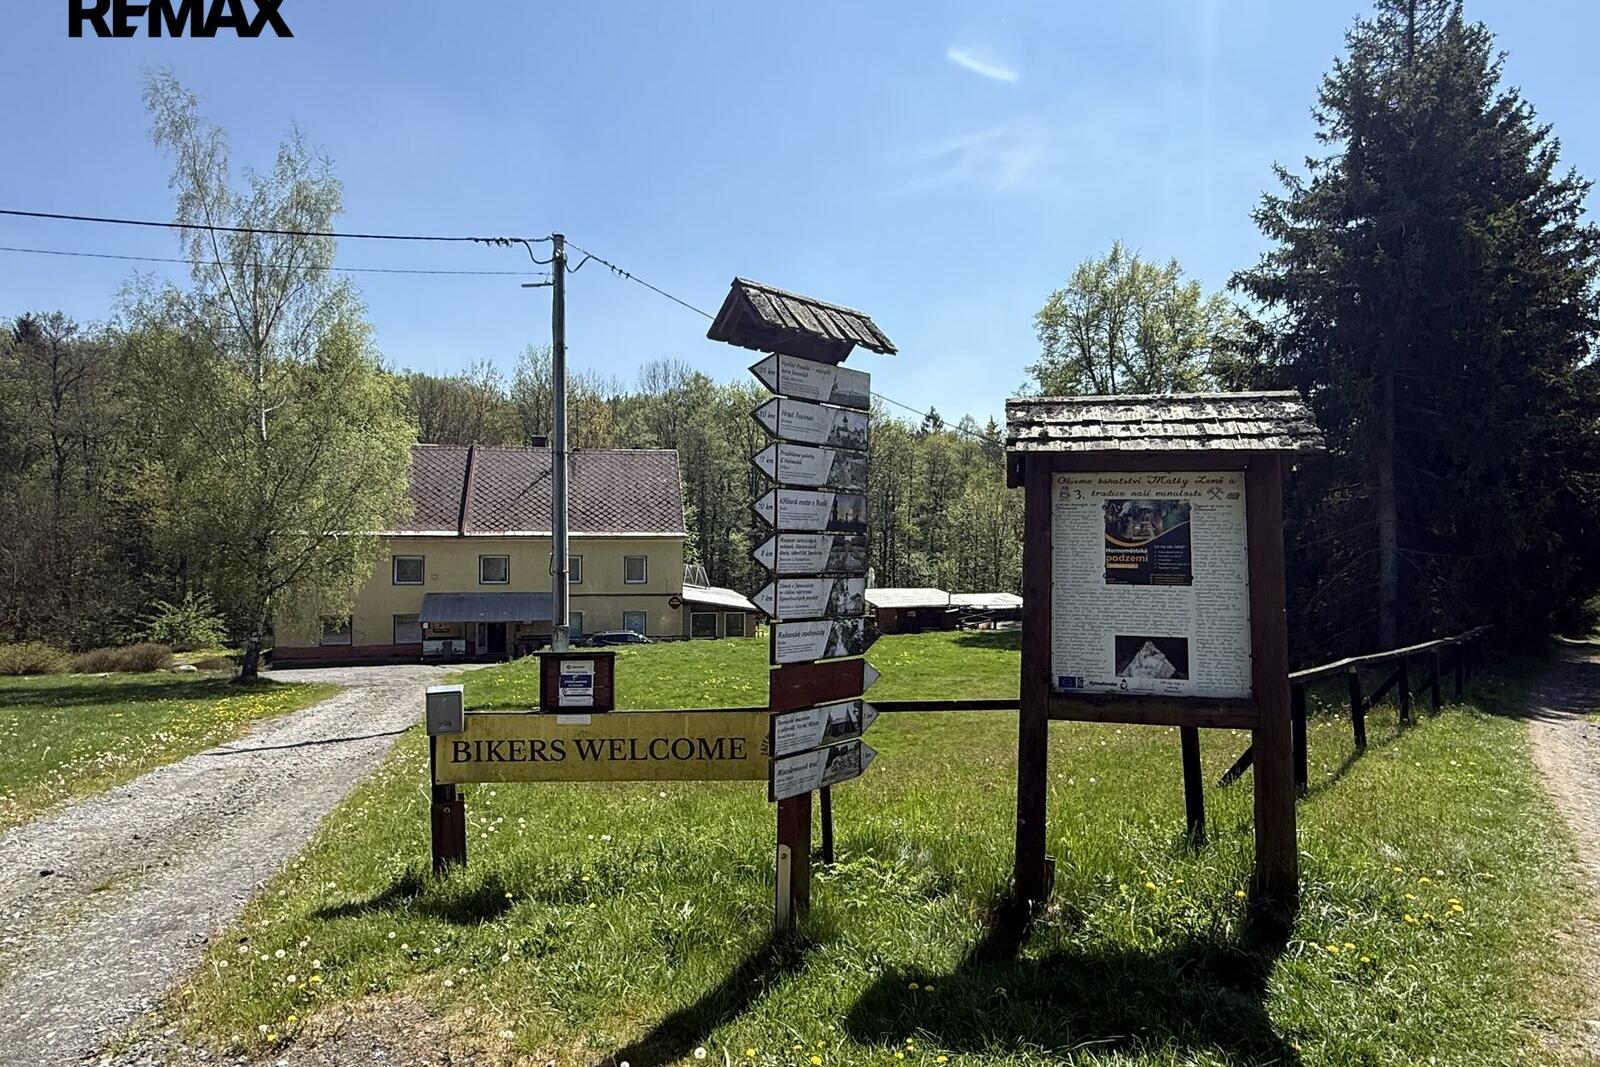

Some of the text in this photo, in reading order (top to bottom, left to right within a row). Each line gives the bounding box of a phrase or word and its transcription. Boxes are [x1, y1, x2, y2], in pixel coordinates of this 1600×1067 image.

[1147, 475, 1188, 489] Matky
[1073, 489, 1085, 500] 3.
[1106, 555, 1149, 564] podzemí
[451, 739, 567, 764] BIKERS
[572, 736, 748, 762] WELCOME
